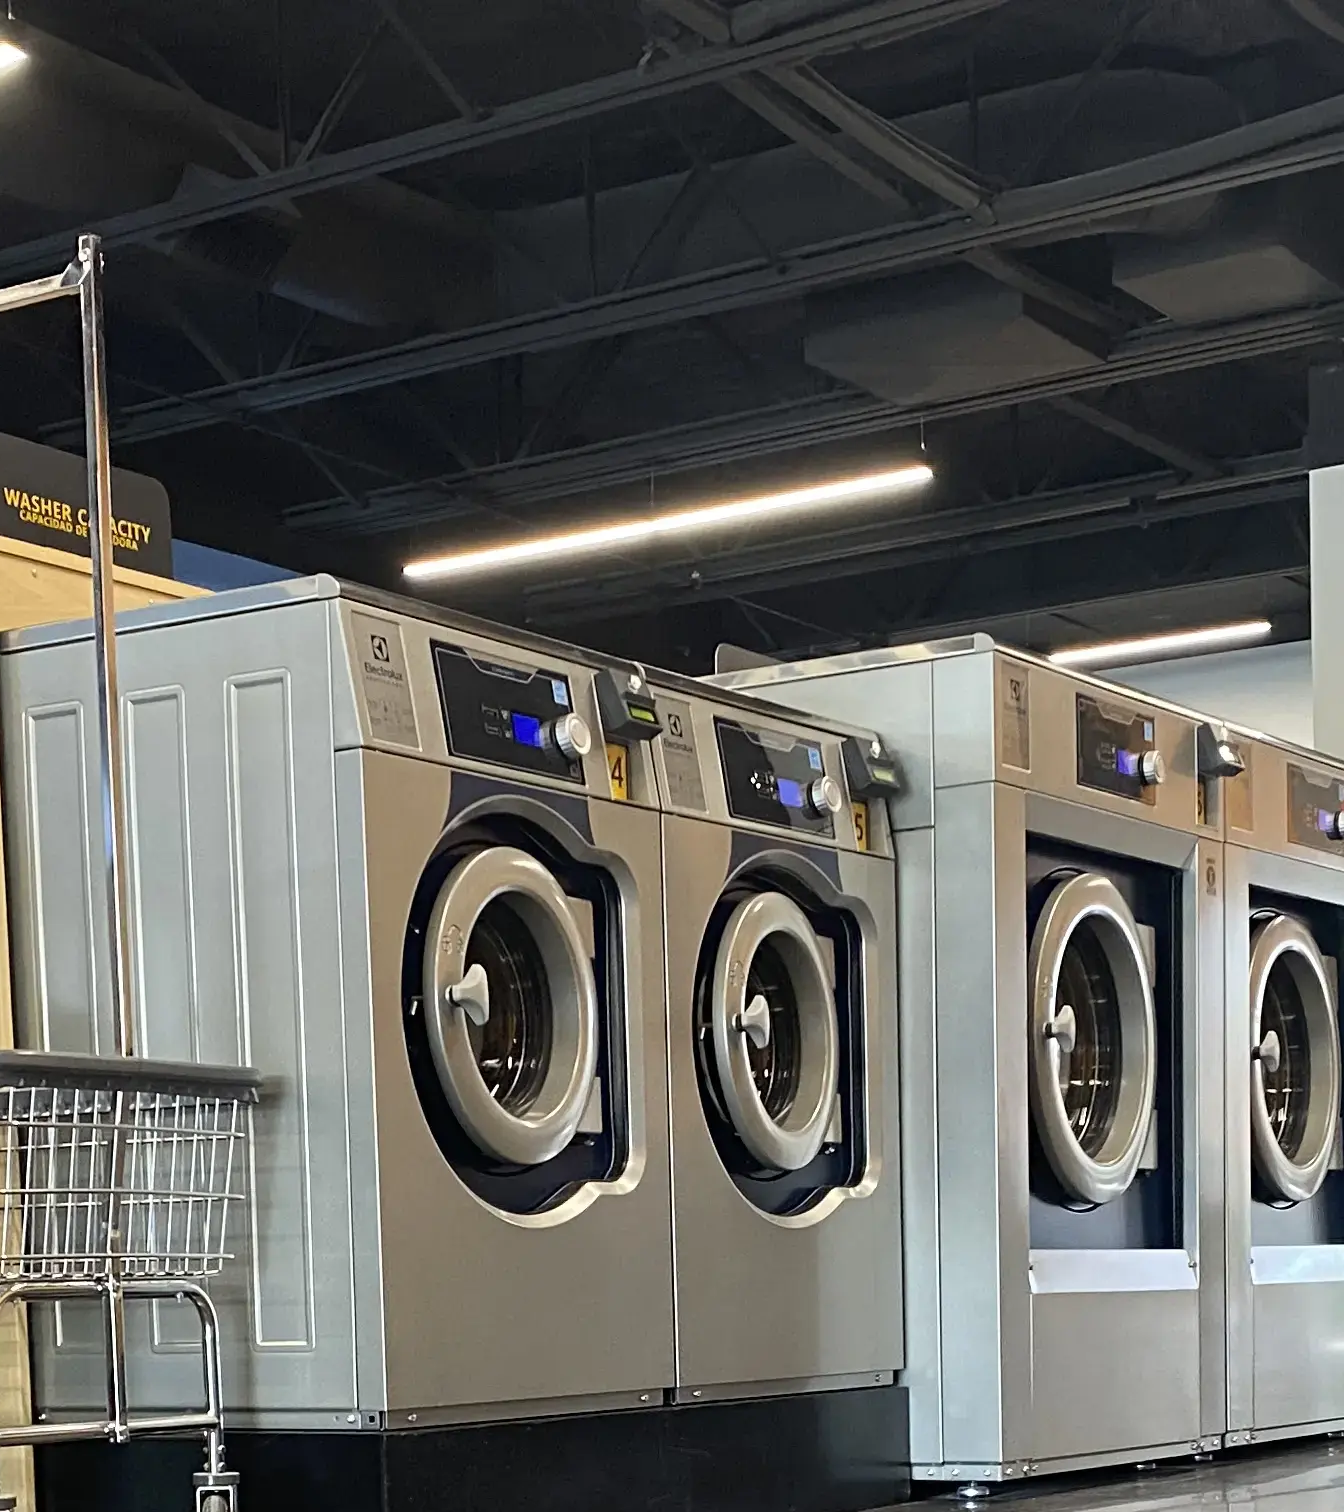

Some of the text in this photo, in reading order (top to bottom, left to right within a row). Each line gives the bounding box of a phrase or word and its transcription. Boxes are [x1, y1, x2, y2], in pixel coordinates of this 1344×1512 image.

[3, 486, 151, 544] WASHER CACITY
[19, 509, 73, 533] CAPACIDAD
[75, 524, 88, 538] DE
[364, 661, 403, 682] Electrolux
